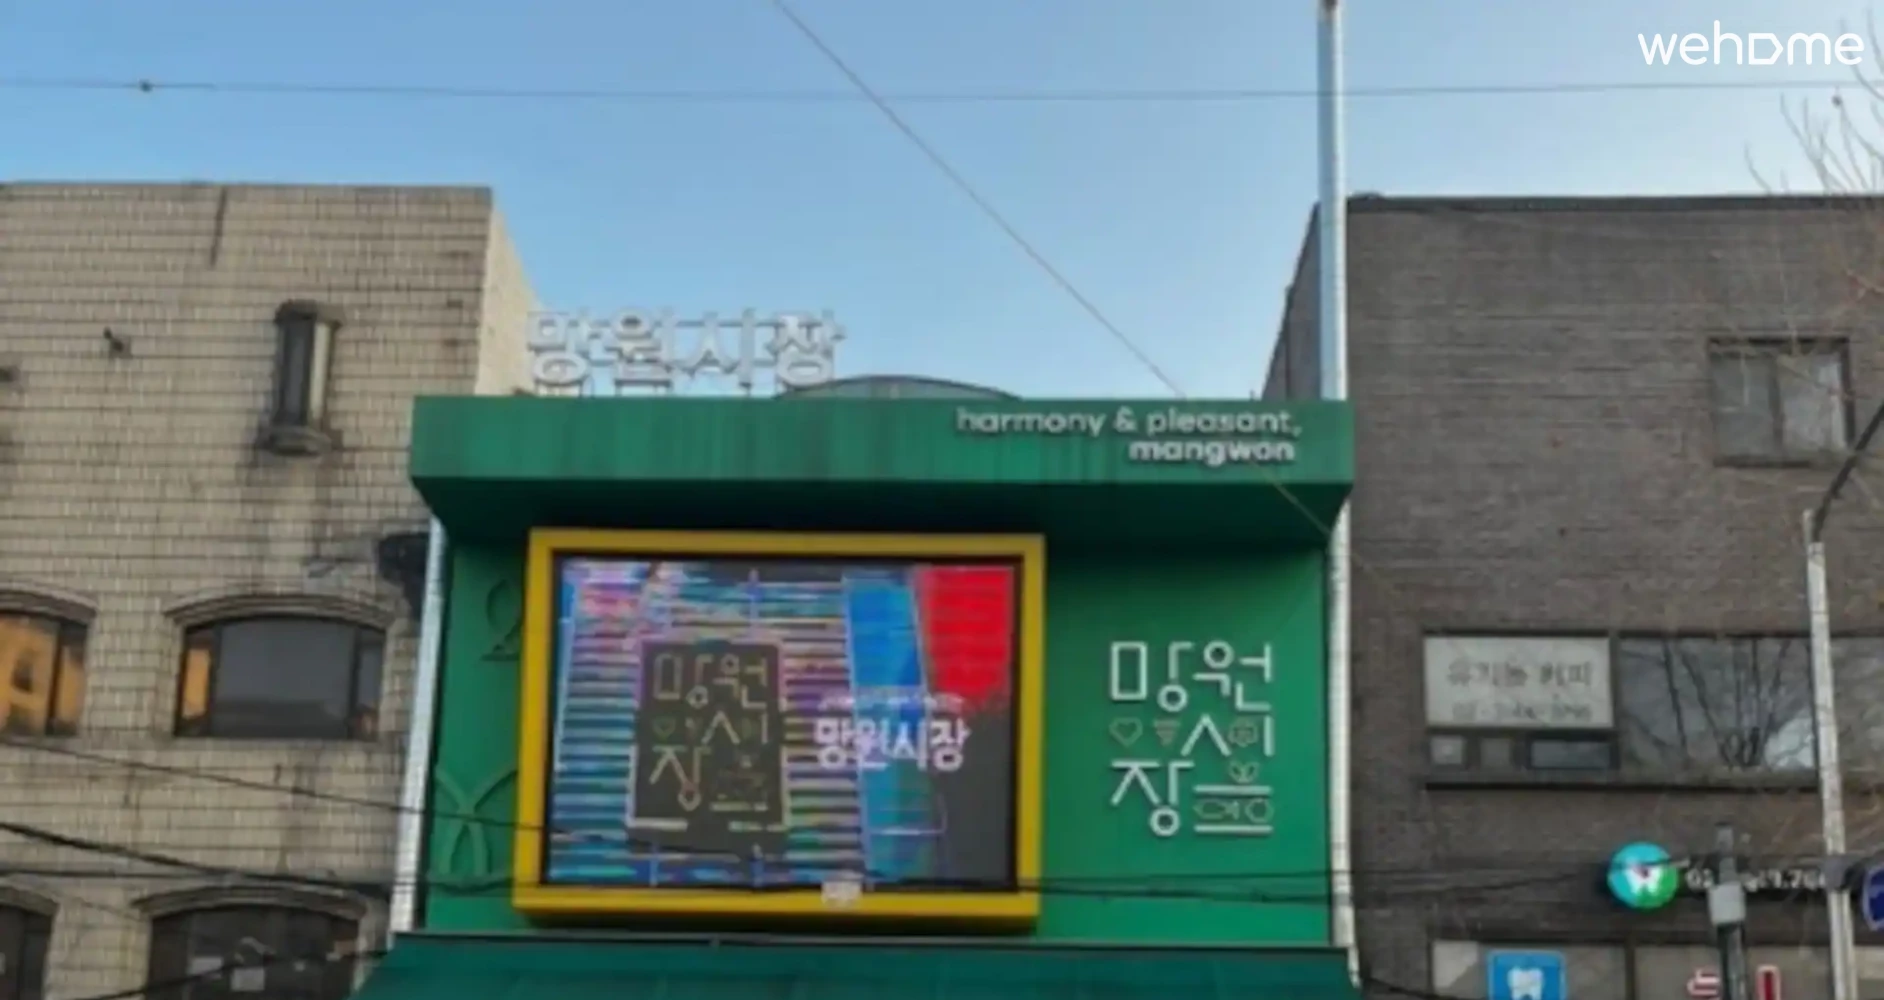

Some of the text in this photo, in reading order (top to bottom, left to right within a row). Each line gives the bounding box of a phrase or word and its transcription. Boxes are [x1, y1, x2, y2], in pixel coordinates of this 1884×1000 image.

[526, 307, 846, 388] 망원시장
[956, 406, 1302, 436] harmony & pleasant,
[1128, 438, 1296, 467] mangwon
[813, 718, 972, 771] 망원시장
